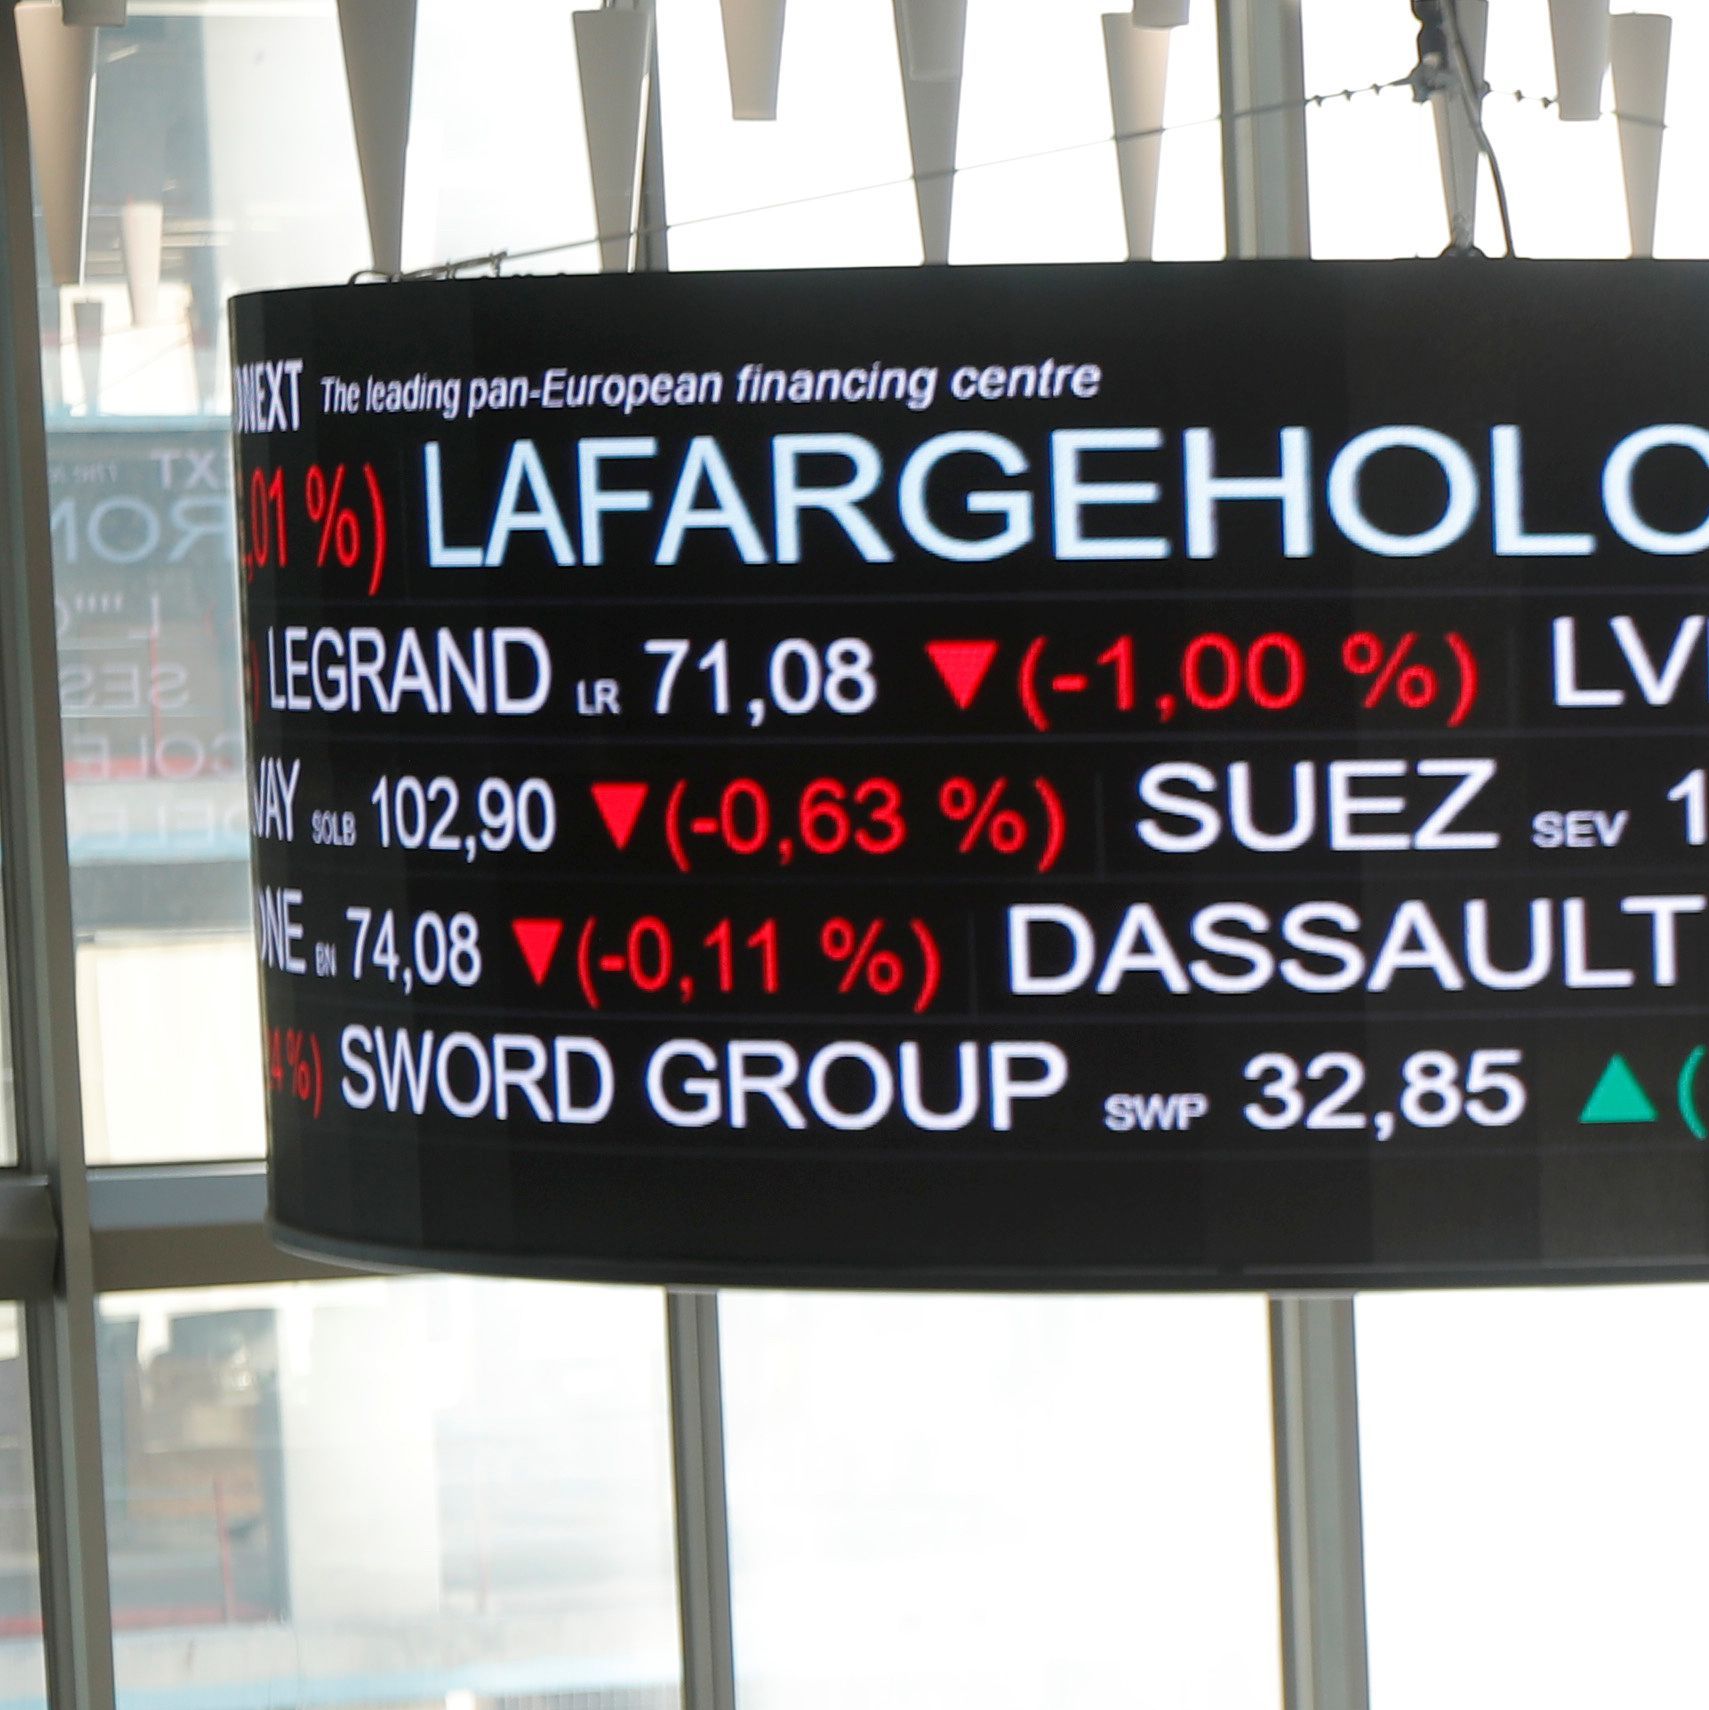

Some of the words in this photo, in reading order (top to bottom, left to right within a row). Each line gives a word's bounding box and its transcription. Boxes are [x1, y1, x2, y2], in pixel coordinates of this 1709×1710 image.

[321, 376, 361, 413] The
[365, 373, 462, 420] leading
[467, 368, 723, 414] pan-European
[736, 362, 939, 410] financing
[951, 358, 1102, 400] centre
[305, 464, 387, 596] %)
[268, 626, 552, 714] LEGRAND
[577, 678, 620, 715] LR
[644, 637, 877, 727] 71,08
[1018, 631, 1307, 731] (-1,00
[1341, 630, 1479, 727] %)
[311, 810, 357, 846] SOLB
[371, 775, 556, 862] 102,90
[664, 776, 908, 872] (-0,63
[938, 776, 1067, 872] %)
[1138, 758, 1499, 852] SUEZ
[1533, 810, 1628, 848] SEV
[315, 941, 337, 977] BN
[346, 907, 482, 994] 74,08
[576, 915, 779, 1007] (-0,11
[820, 916, 942, 1013] %)
[1009, 895, 1706, 994] DASSAULT
[341, 1024, 615, 1124] SWORD
[647, 1039, 1068, 1131] GROUP
[1104, 1093, 1208, 1131] SWP
[1245, 1049, 1526, 1141] 32,85
